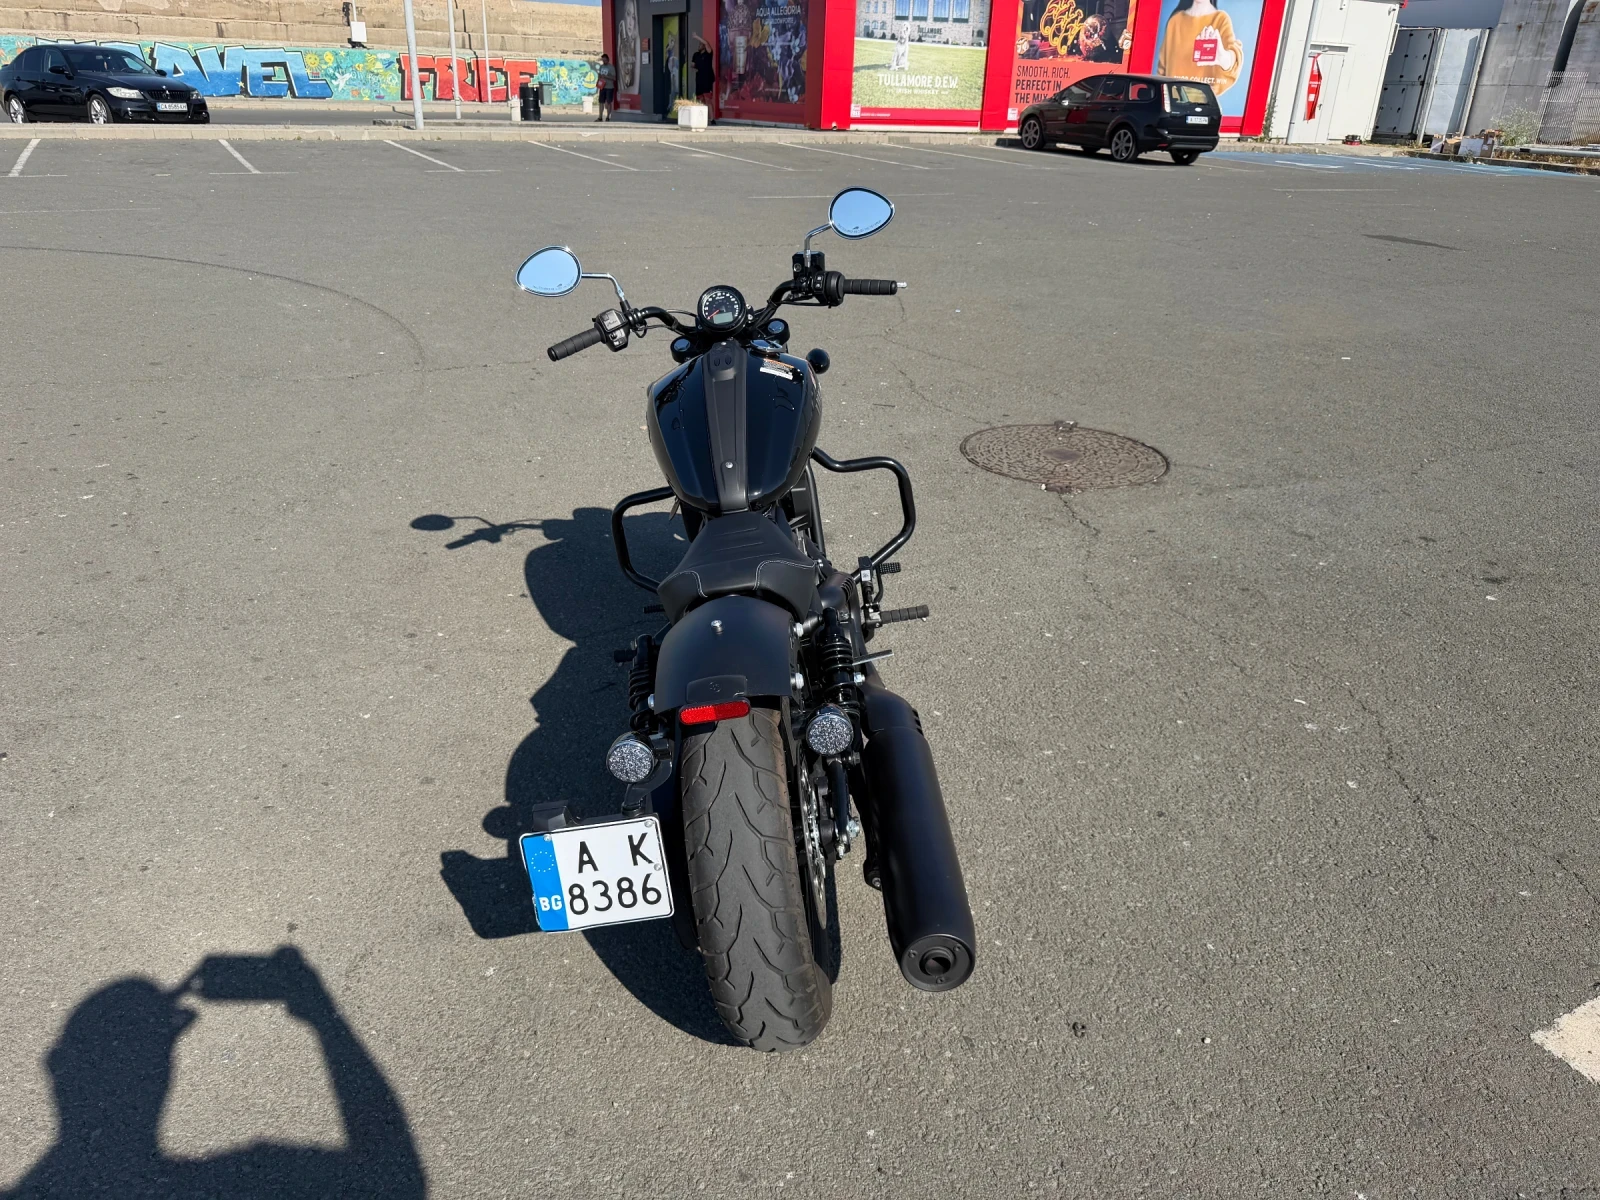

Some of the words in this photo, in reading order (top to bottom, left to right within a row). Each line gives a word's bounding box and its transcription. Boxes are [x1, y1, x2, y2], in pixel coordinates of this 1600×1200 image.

[756, 7, 770, 17] AQUA
[771, 5, 801, 16] ALLEGORIA
[36, 37, 333, 99] AVEL
[1017, 65, 1050, 78] SMOOTH.
[1051, 66, 1070, 79] RICH.
[877, 73, 933, 88] TULLAMORE
[1015, 79, 1052, 91] PERFECT
[1053, 80, 1062, 92] IN
[1015, 92, 1031, 104] THE
[578, 841, 599, 874] A
[627, 832, 654, 866] K
[568, 872, 662, 915] 8386
[539, 894, 563, 911] BG
